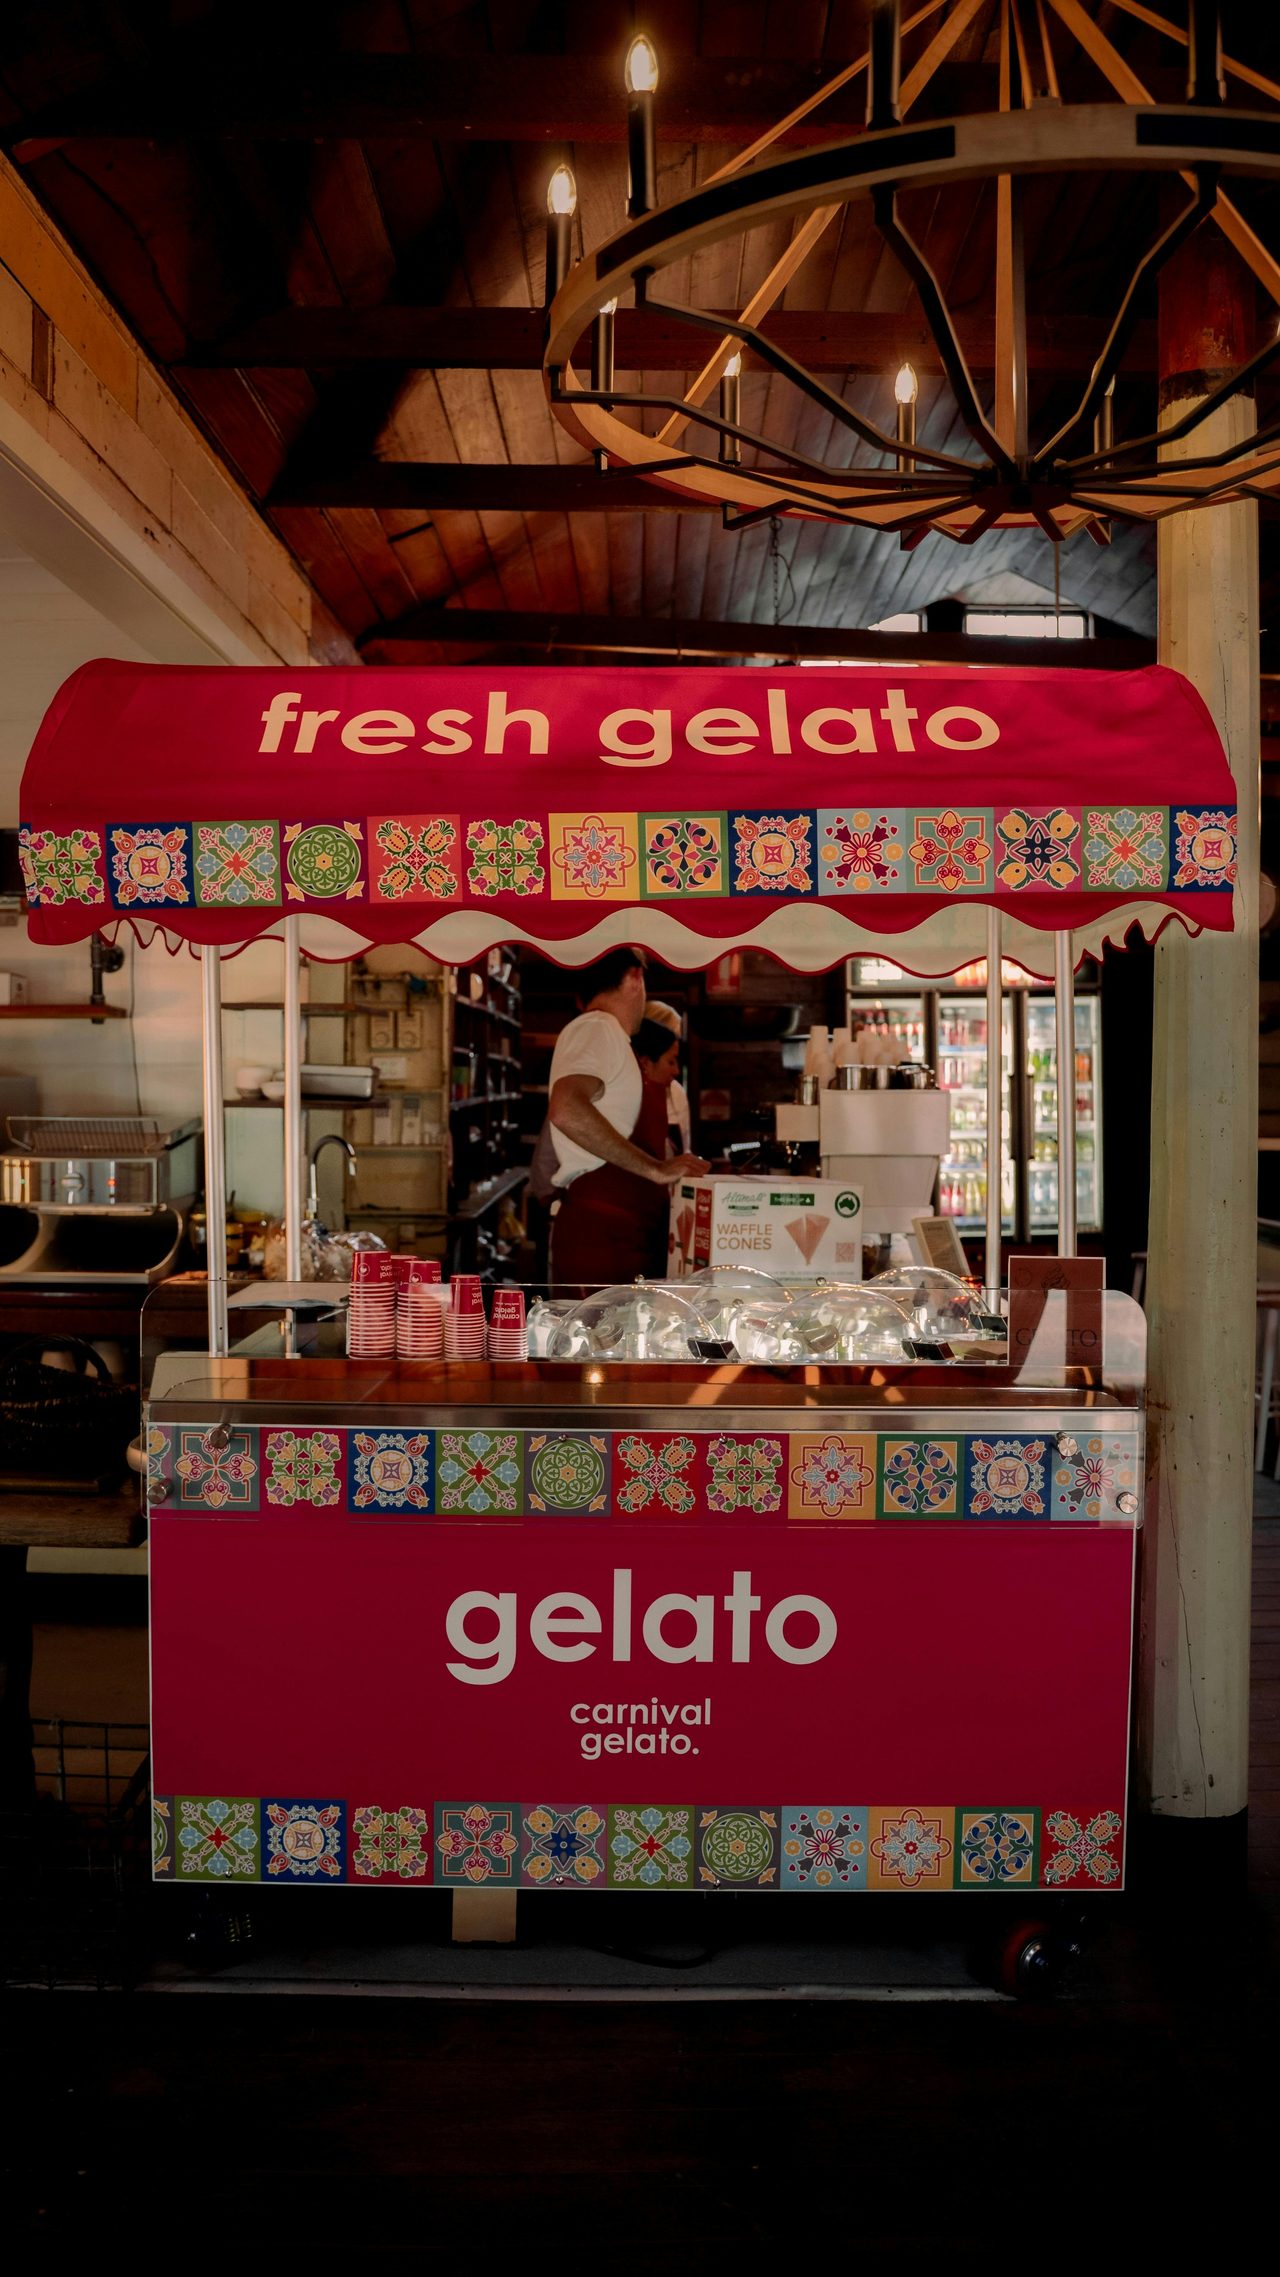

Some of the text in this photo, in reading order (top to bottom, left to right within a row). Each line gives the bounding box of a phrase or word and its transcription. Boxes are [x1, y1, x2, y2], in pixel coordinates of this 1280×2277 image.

[258, 688, 1001, 768] fresh gelato
[716, 1223, 773, 1236] WAFFLE
[716, 1237, 772, 1250] CONES
[492, 1312, 520, 1320] carnival
[445, 1568, 838, 1686] gelato
[570, 1696, 711, 1726] carnival
[580, 1726, 700, 1761] gelato.
